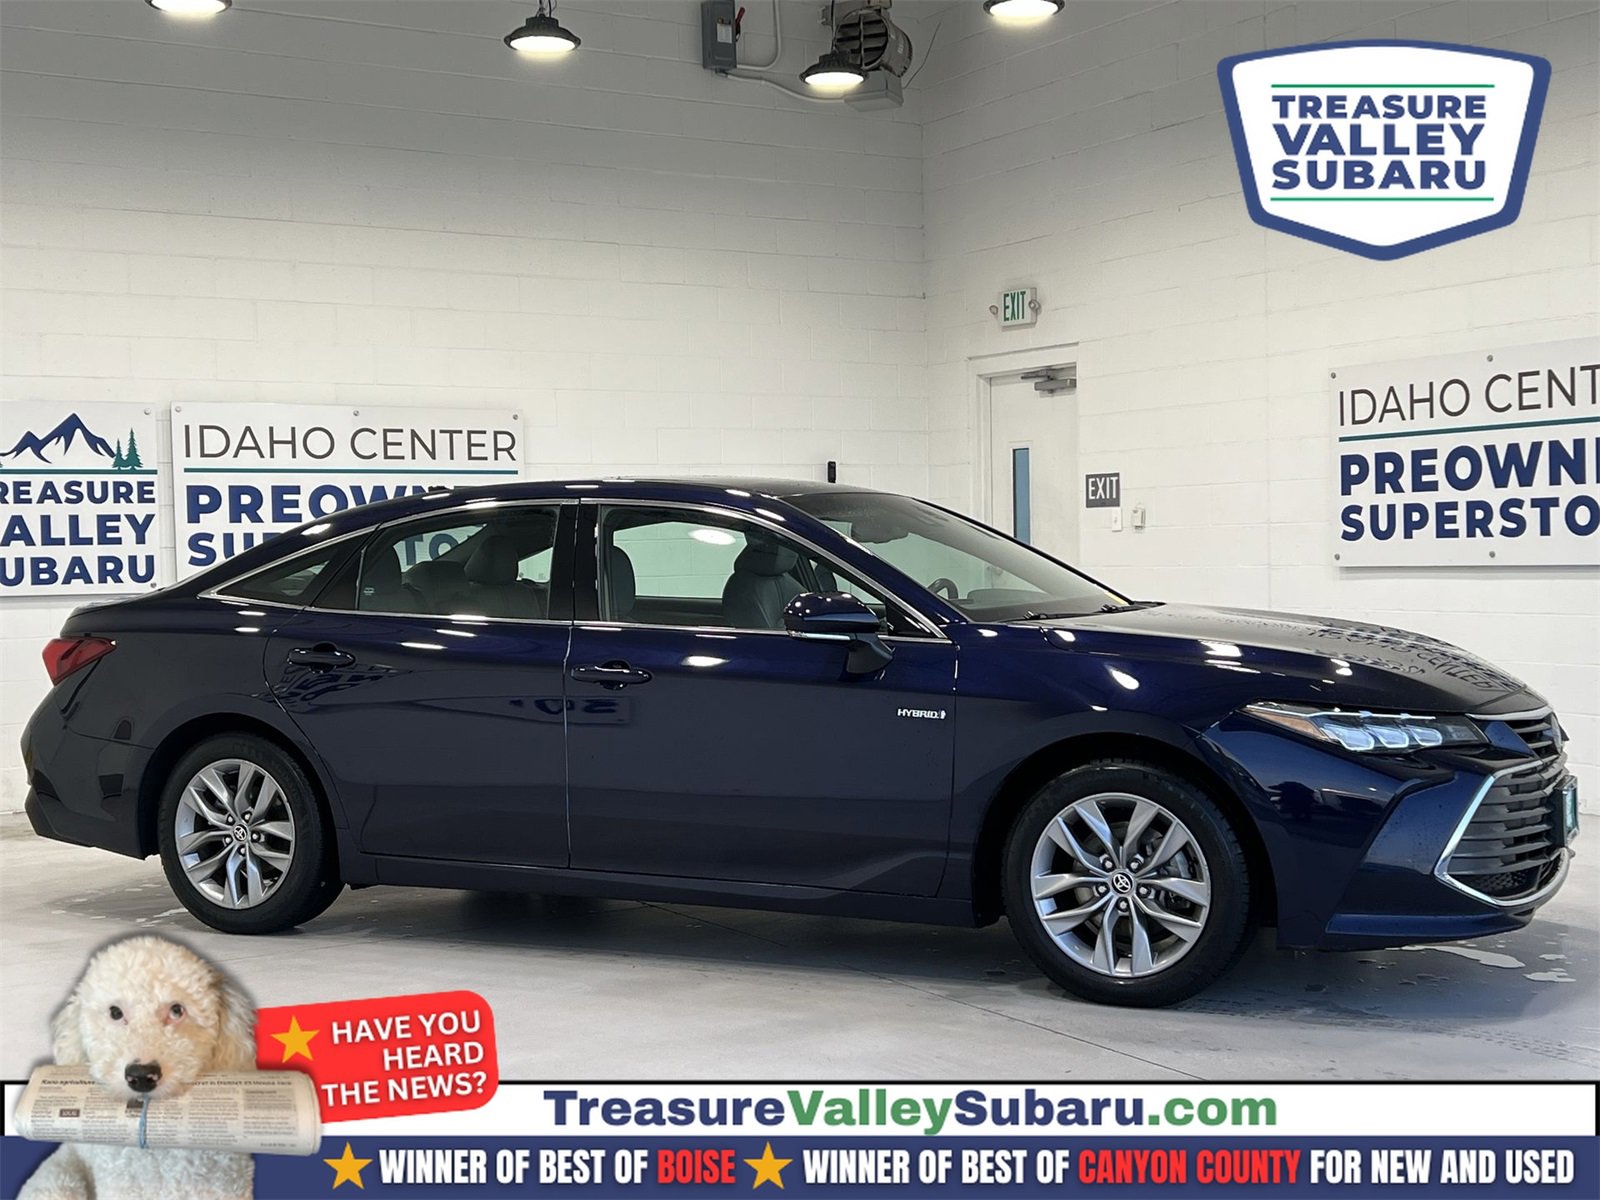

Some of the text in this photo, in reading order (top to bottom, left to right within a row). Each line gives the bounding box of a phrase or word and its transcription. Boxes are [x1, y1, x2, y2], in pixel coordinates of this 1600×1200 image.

[1003, 290, 1027, 322] EXIT
[1339, 378, 1471, 427] IDAHO
[184, 424, 516, 462] IDAHO CENTER
[1340, 436, 1600, 497] PREOWN
[1088, 476, 1119, 500] EXIT
[0, 514, 156, 547] ALLEY
[1341, 495, 1600, 541] SUPERSTO
[0, 555, 155, 587] UBARU
[897, 708, 939, 719] HYBRID
